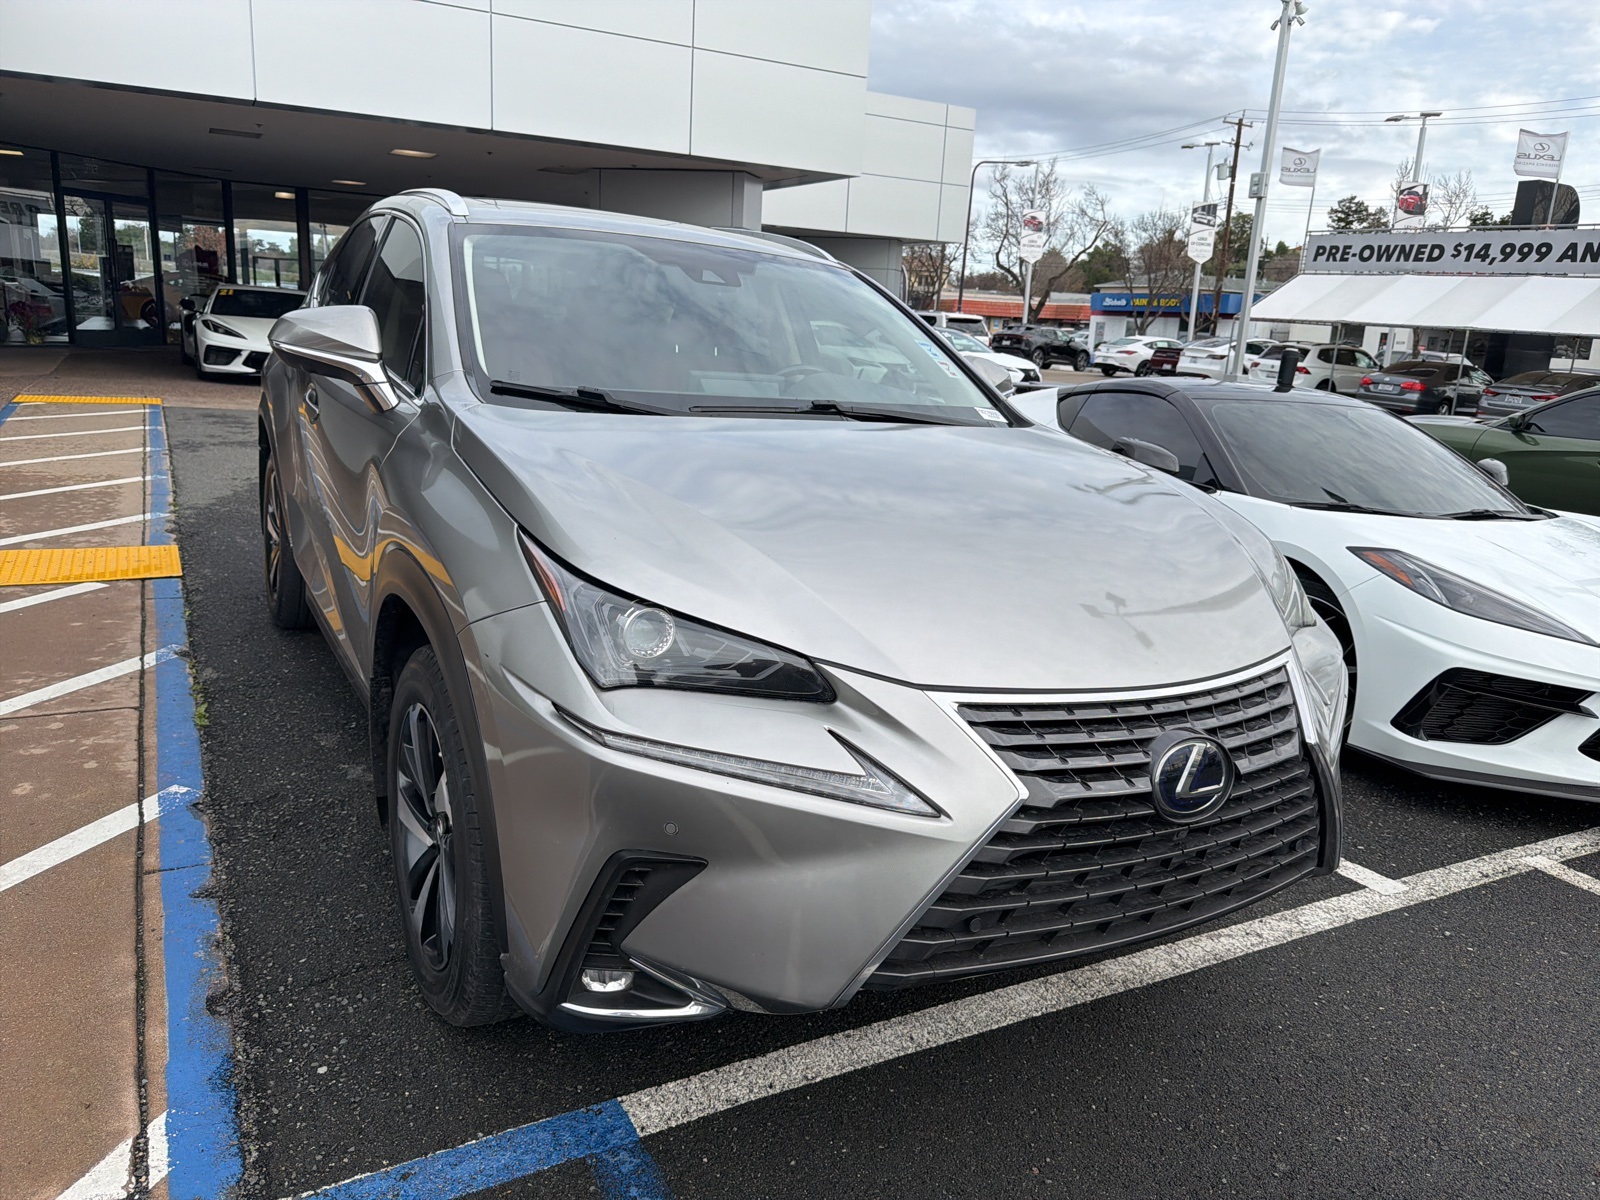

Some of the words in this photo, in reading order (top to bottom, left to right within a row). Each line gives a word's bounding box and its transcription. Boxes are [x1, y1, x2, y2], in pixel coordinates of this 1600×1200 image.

[1312, 244, 1445, 263] PRE-OWNED
[1450, 242, 1553, 266] $14,999
[1555, 242, 1600, 263] AN
